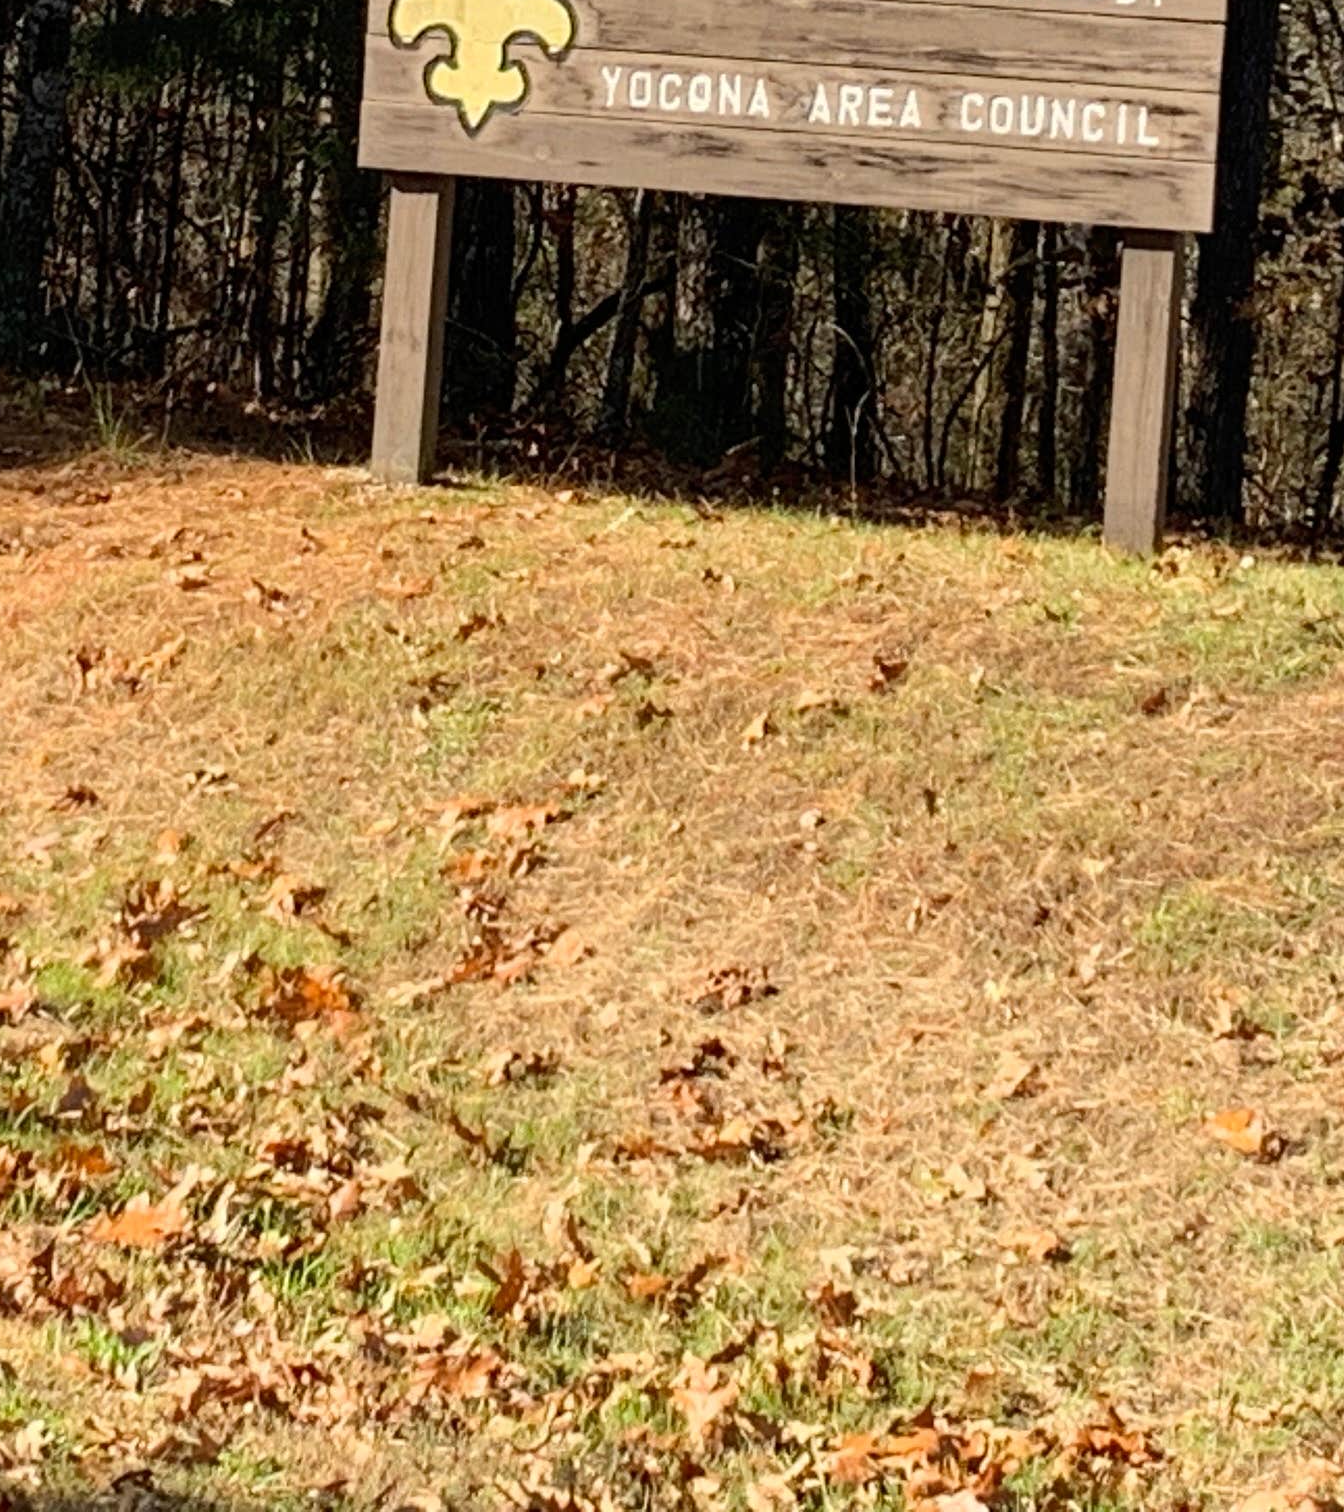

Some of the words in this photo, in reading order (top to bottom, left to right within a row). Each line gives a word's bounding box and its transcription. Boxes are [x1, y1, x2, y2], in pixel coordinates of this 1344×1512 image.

[599, 66, 770, 118] YOCONA
[807, 83, 921, 127] AREA
[958, 92, 1161, 146] COUNCIL
